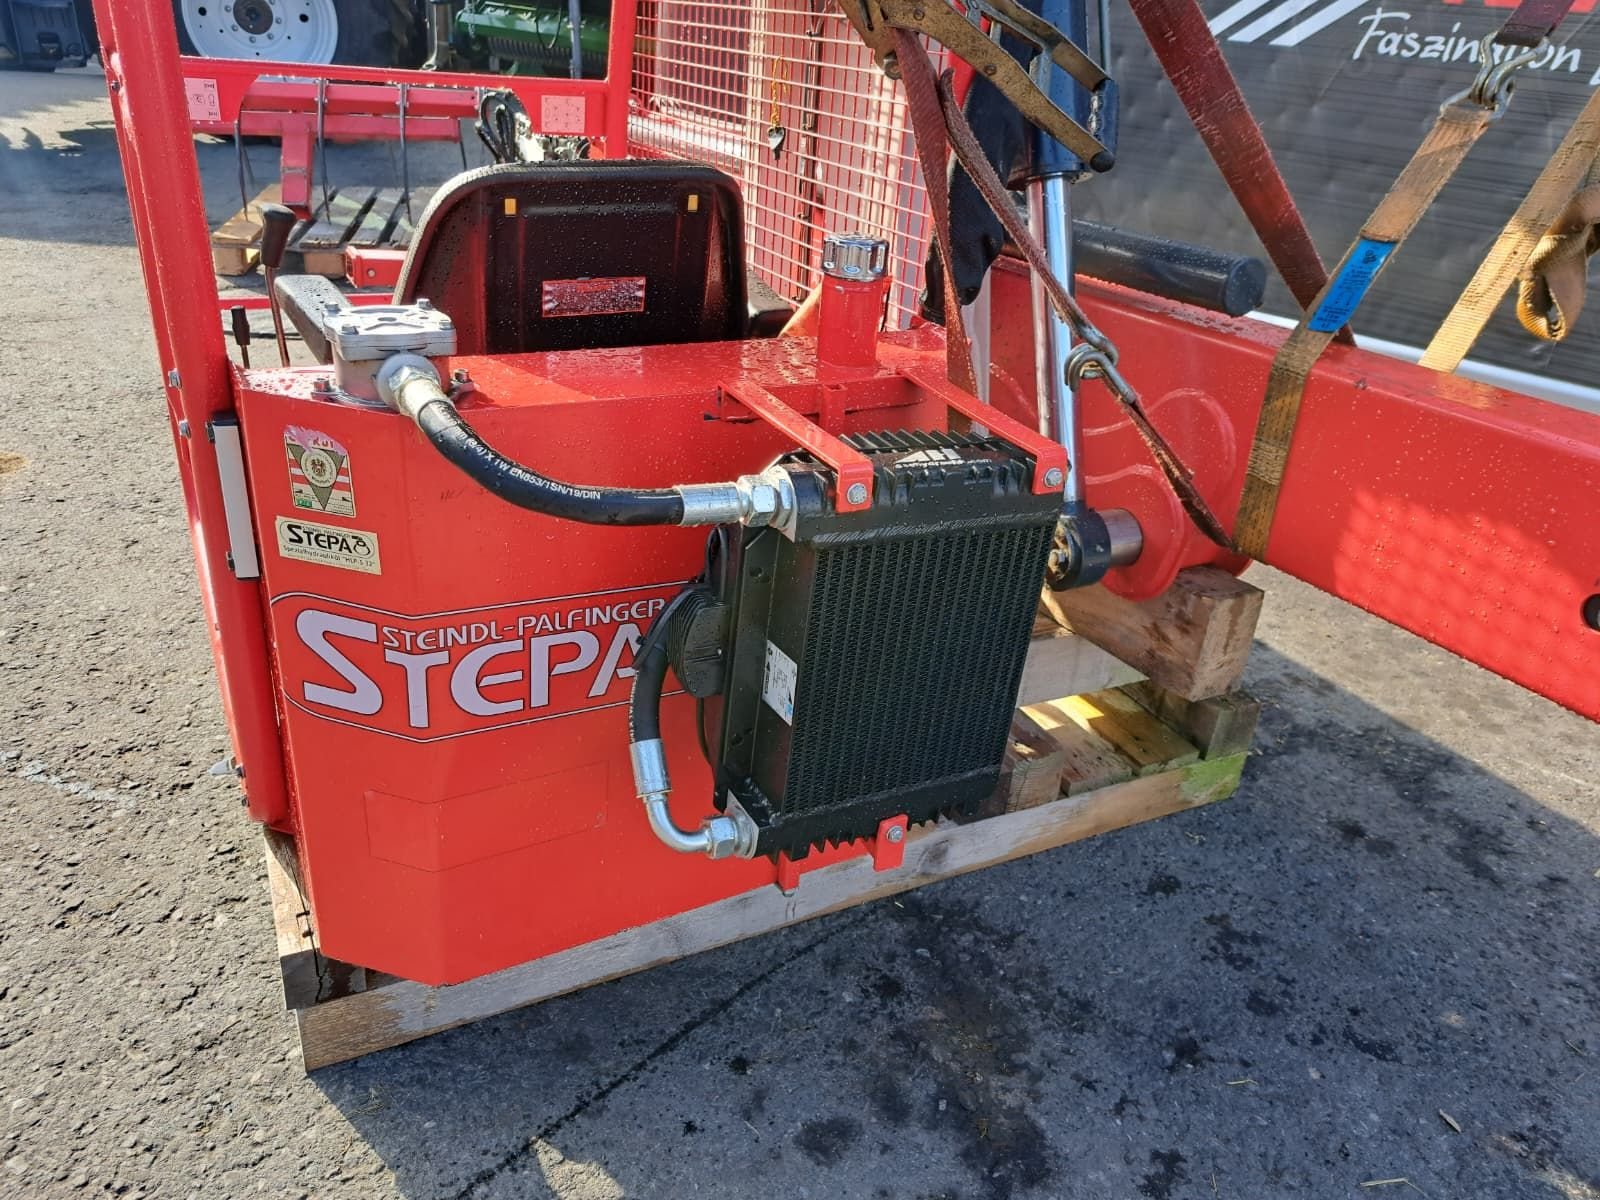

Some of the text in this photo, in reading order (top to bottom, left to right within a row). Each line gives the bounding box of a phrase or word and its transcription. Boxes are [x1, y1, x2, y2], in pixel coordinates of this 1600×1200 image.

[1353, 7, 1582, 73] Faszinon
[287, 523, 353, 554] STEPA
[382, 598, 666, 651] STEINDL-PALFINGER
[296, 608, 642, 729] STEPA
